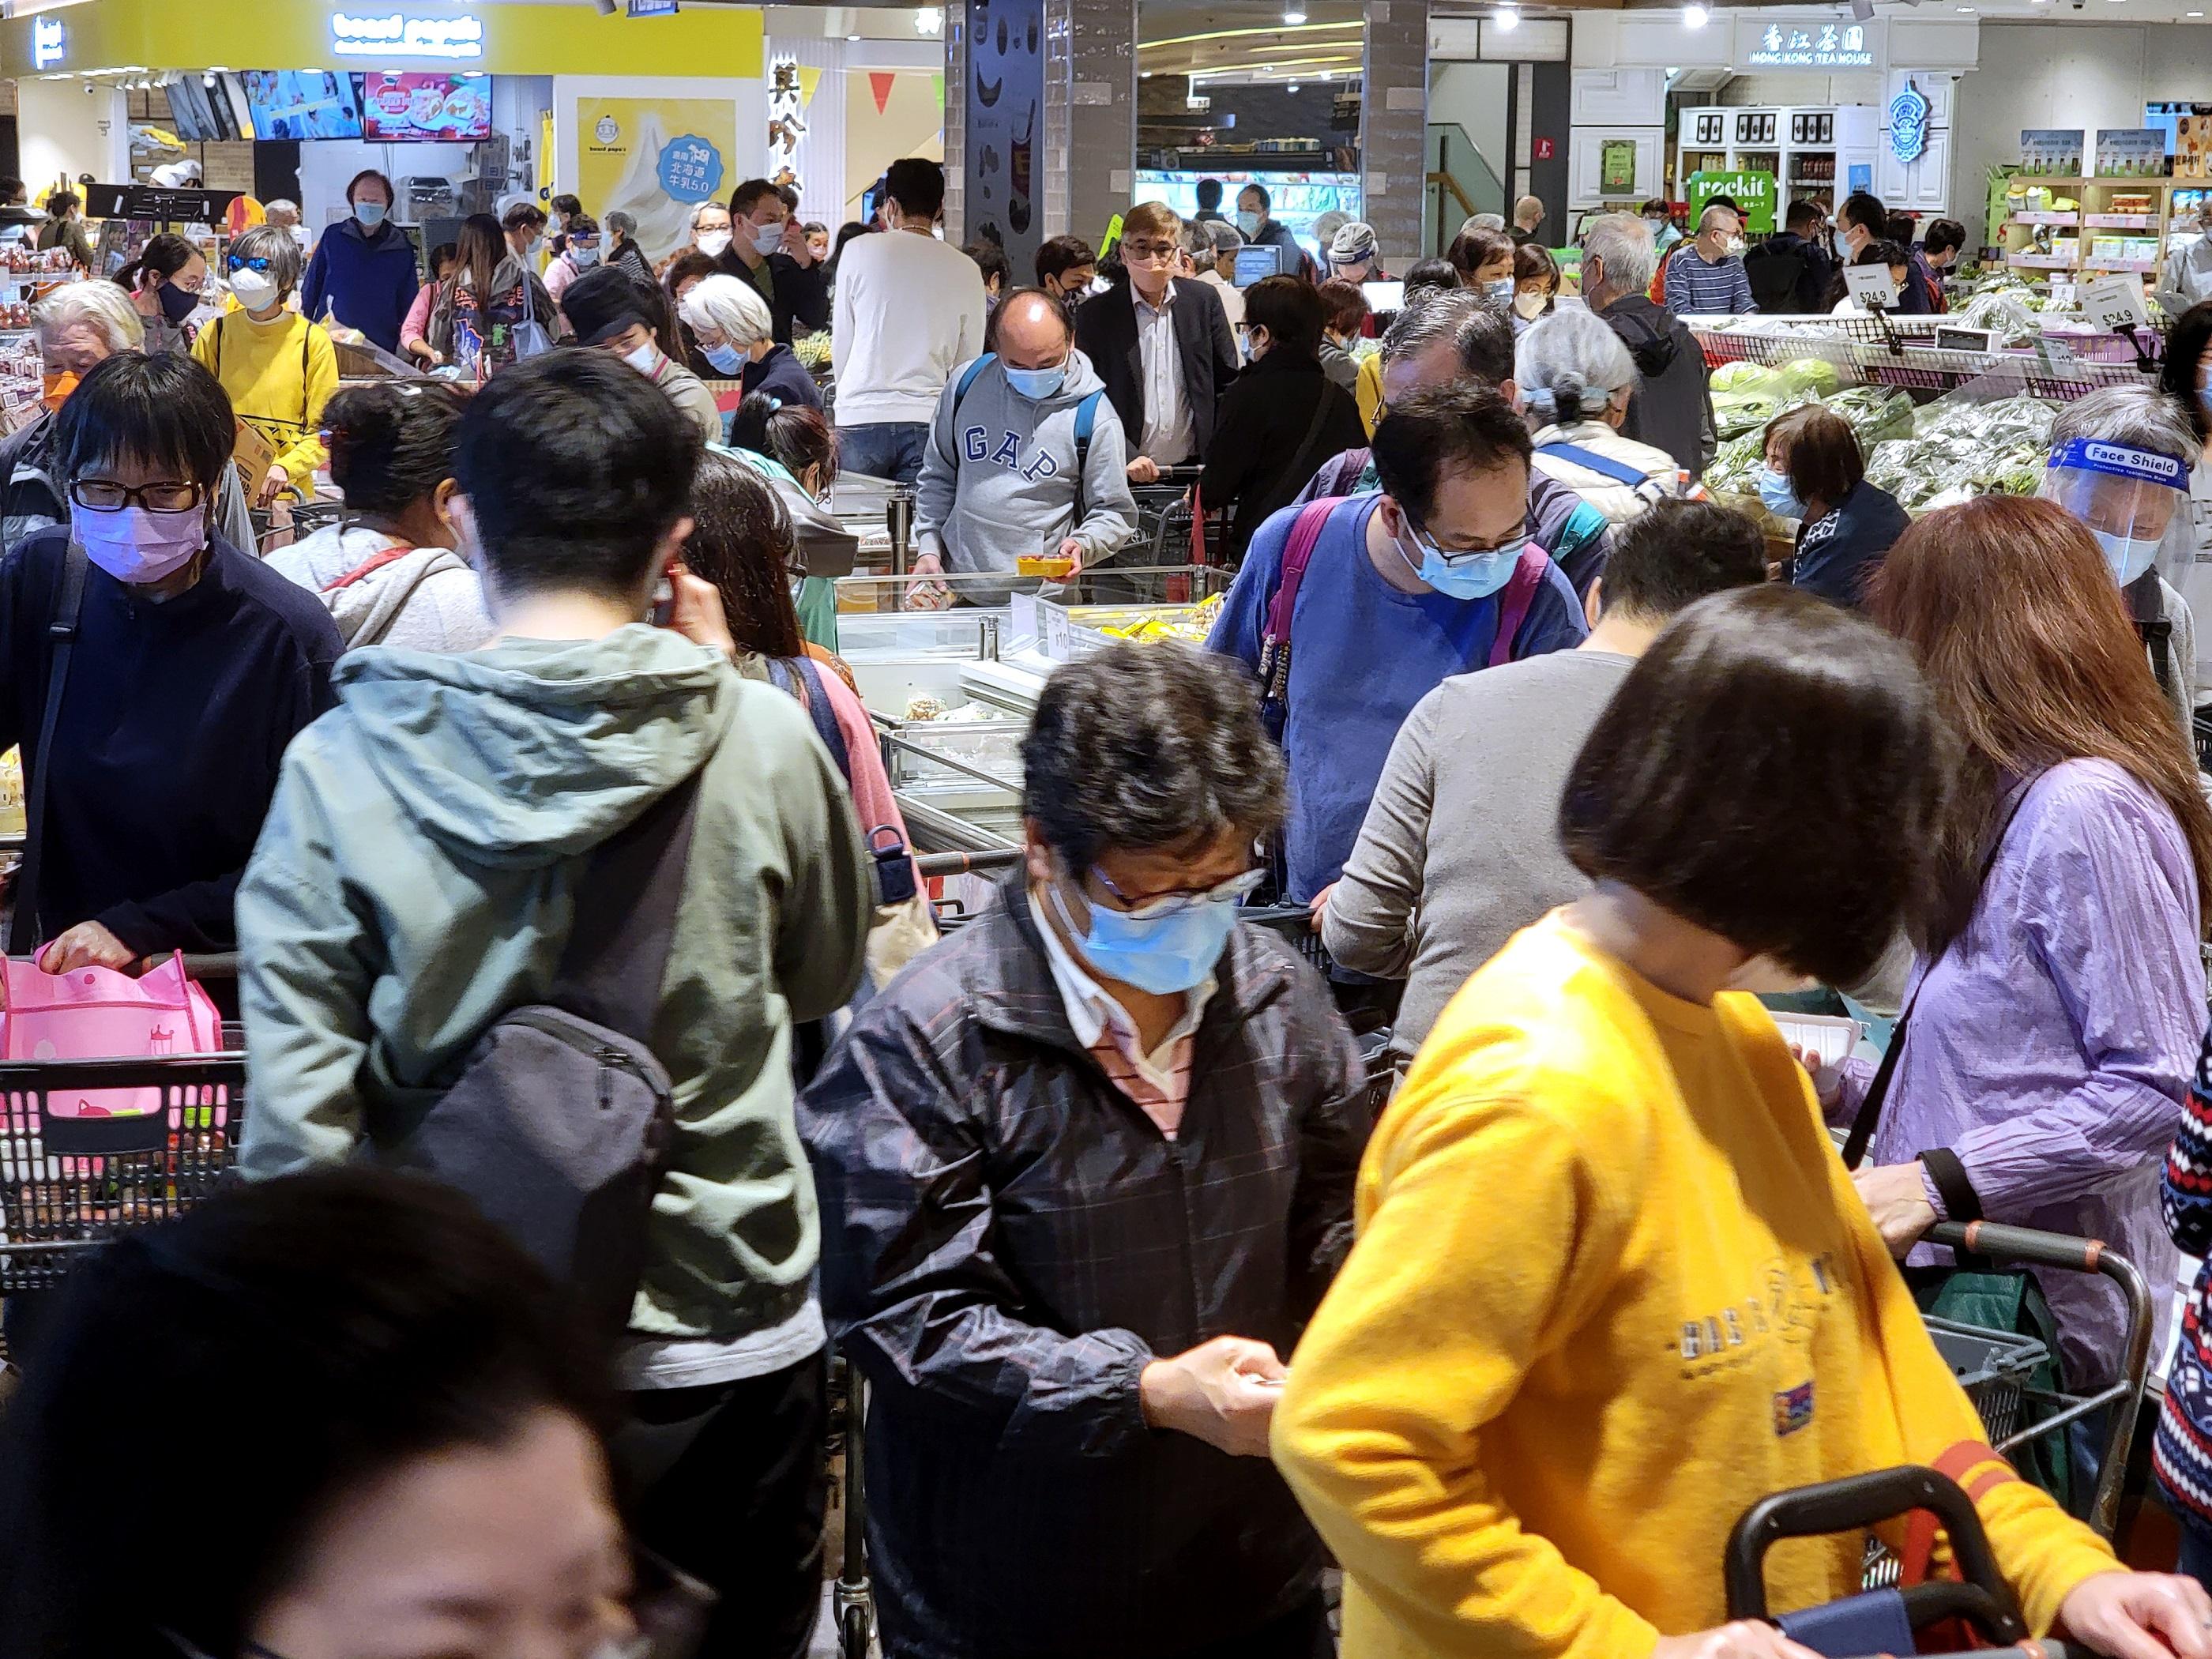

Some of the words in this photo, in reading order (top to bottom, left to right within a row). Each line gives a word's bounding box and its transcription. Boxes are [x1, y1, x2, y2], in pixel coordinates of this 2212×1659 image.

[1749, 51, 1783, 64] HONG
[1783, 51, 1813, 64] KONG
[1815, 51, 1837, 64] TEA
[1837, 51, 1872, 65] HOUSE
[671, 162, 705, 179] 北海道
[1859, 290, 1887, 303] $24.9
[2102, 309, 2134, 326] $24.9
[964, 424, 1059, 483] GAP
[2093, 447, 2125, 462] Face
[2130, 454, 2174, 473] Shield
